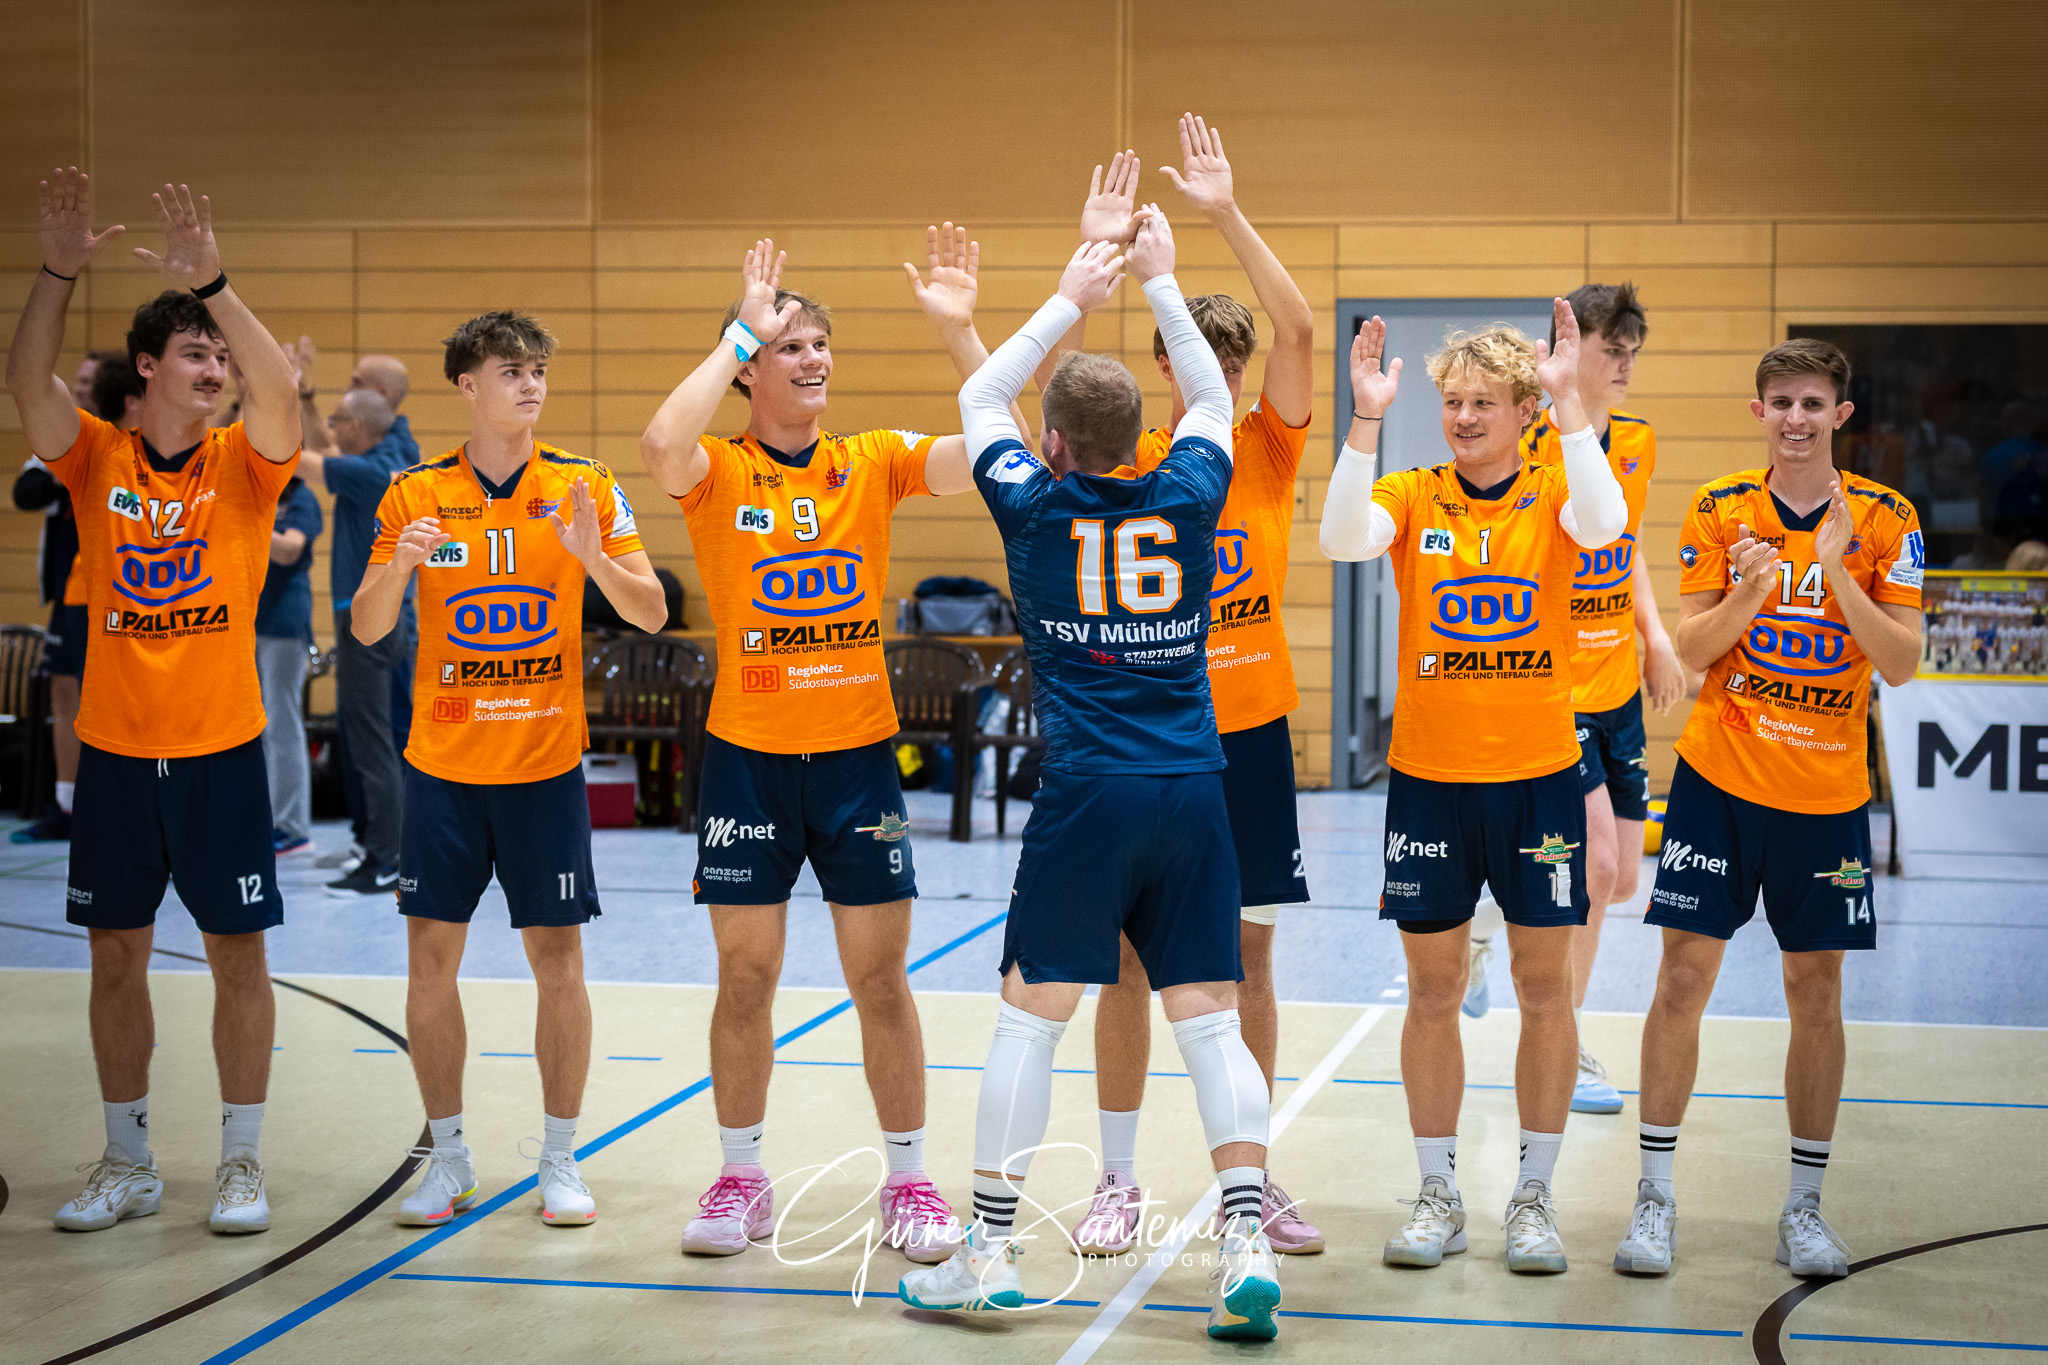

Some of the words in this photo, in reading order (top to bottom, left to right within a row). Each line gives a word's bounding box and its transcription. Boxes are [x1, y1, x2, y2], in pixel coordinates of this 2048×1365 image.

[113, 492, 142, 516] EVIS
[437, 503, 483, 516] panzeri
[148, 498, 186, 539] 12
[466, 513, 483, 521] sport
[741, 510, 769, 530] EVIS
[792, 496, 821, 542] 9
[485, 527, 516, 576] 11
[1424, 534, 1451, 551] EVIS
[1479, 526, 1492, 565] 1
[431, 547, 463, 563] EVIS
[1070, 514, 1183, 616] 16
[122, 549, 201, 589] ODU
[761, 562, 857, 601] ODU
[1779, 561, 1827, 608] 14
[1438, 590, 1533, 626] ODU
[1570, 591, 1631, 613] PALITZ
[122, 604, 229, 632] PALITZA
[455, 600, 548, 635] ODU
[1039, 619, 1091, 643] TSV
[1100, 613, 1201, 644] Mühldorf
[1247, 614, 1271, 626] GmbH
[148, 632, 168, 640] UND
[171, 627, 203, 639] TIEFBAU
[204, 624, 230, 634] GmbH
[770, 618, 880, 647] PALITZA
[771, 646, 800, 655] HOCH
[802, 643, 823, 653] UND
[826, 641, 856, 652] TIEFBAU
[858, 638, 881, 648] GmbH
[1123, 641, 1197, 660] STADTWERKE
[1749, 625, 1845, 665] ODU
[461, 654, 562, 680] PALITZA
[787, 664, 844, 678] RegioNetz
[1443, 650, 1553, 672] PALITZA
[462, 679, 488, 688] HOCH
[490, 679, 510, 687] UND
[512, 676, 545, 686] TIEFBAU
[788, 672, 880, 690] Südostbayernbahn
[1443, 672, 1470, 680] HOCH
[1473, 671, 1494, 680] UND
[1496, 670, 1530, 679] TIEFBAU
[1532, 670, 1553, 678] GmbH
[1748, 673, 1855, 710] PALITZA
[474, 705, 563, 722] Südostbayernbahn
[475, 697, 531, 711] RegioNetz
[1774, 700, 1796, 711] UND
[1798, 704, 1832, 717] TIEFBAU
[1758, 714, 1815, 737] RegioNetz
[1756, 726, 1847, 752] Südostbayernbahn
[702, 866, 752, 877] panzeri
[889, 848, 903, 874] 9
[237, 873, 264, 906] 12
[557, 872, 575, 901] 11
[732, 875, 752, 884] sport
[1402, 890, 1420, 899] sport
[1652, 887, 1700, 905] panzeri
[1677, 901, 1698, 911] sport
[1845, 894, 1871, 926] 14
